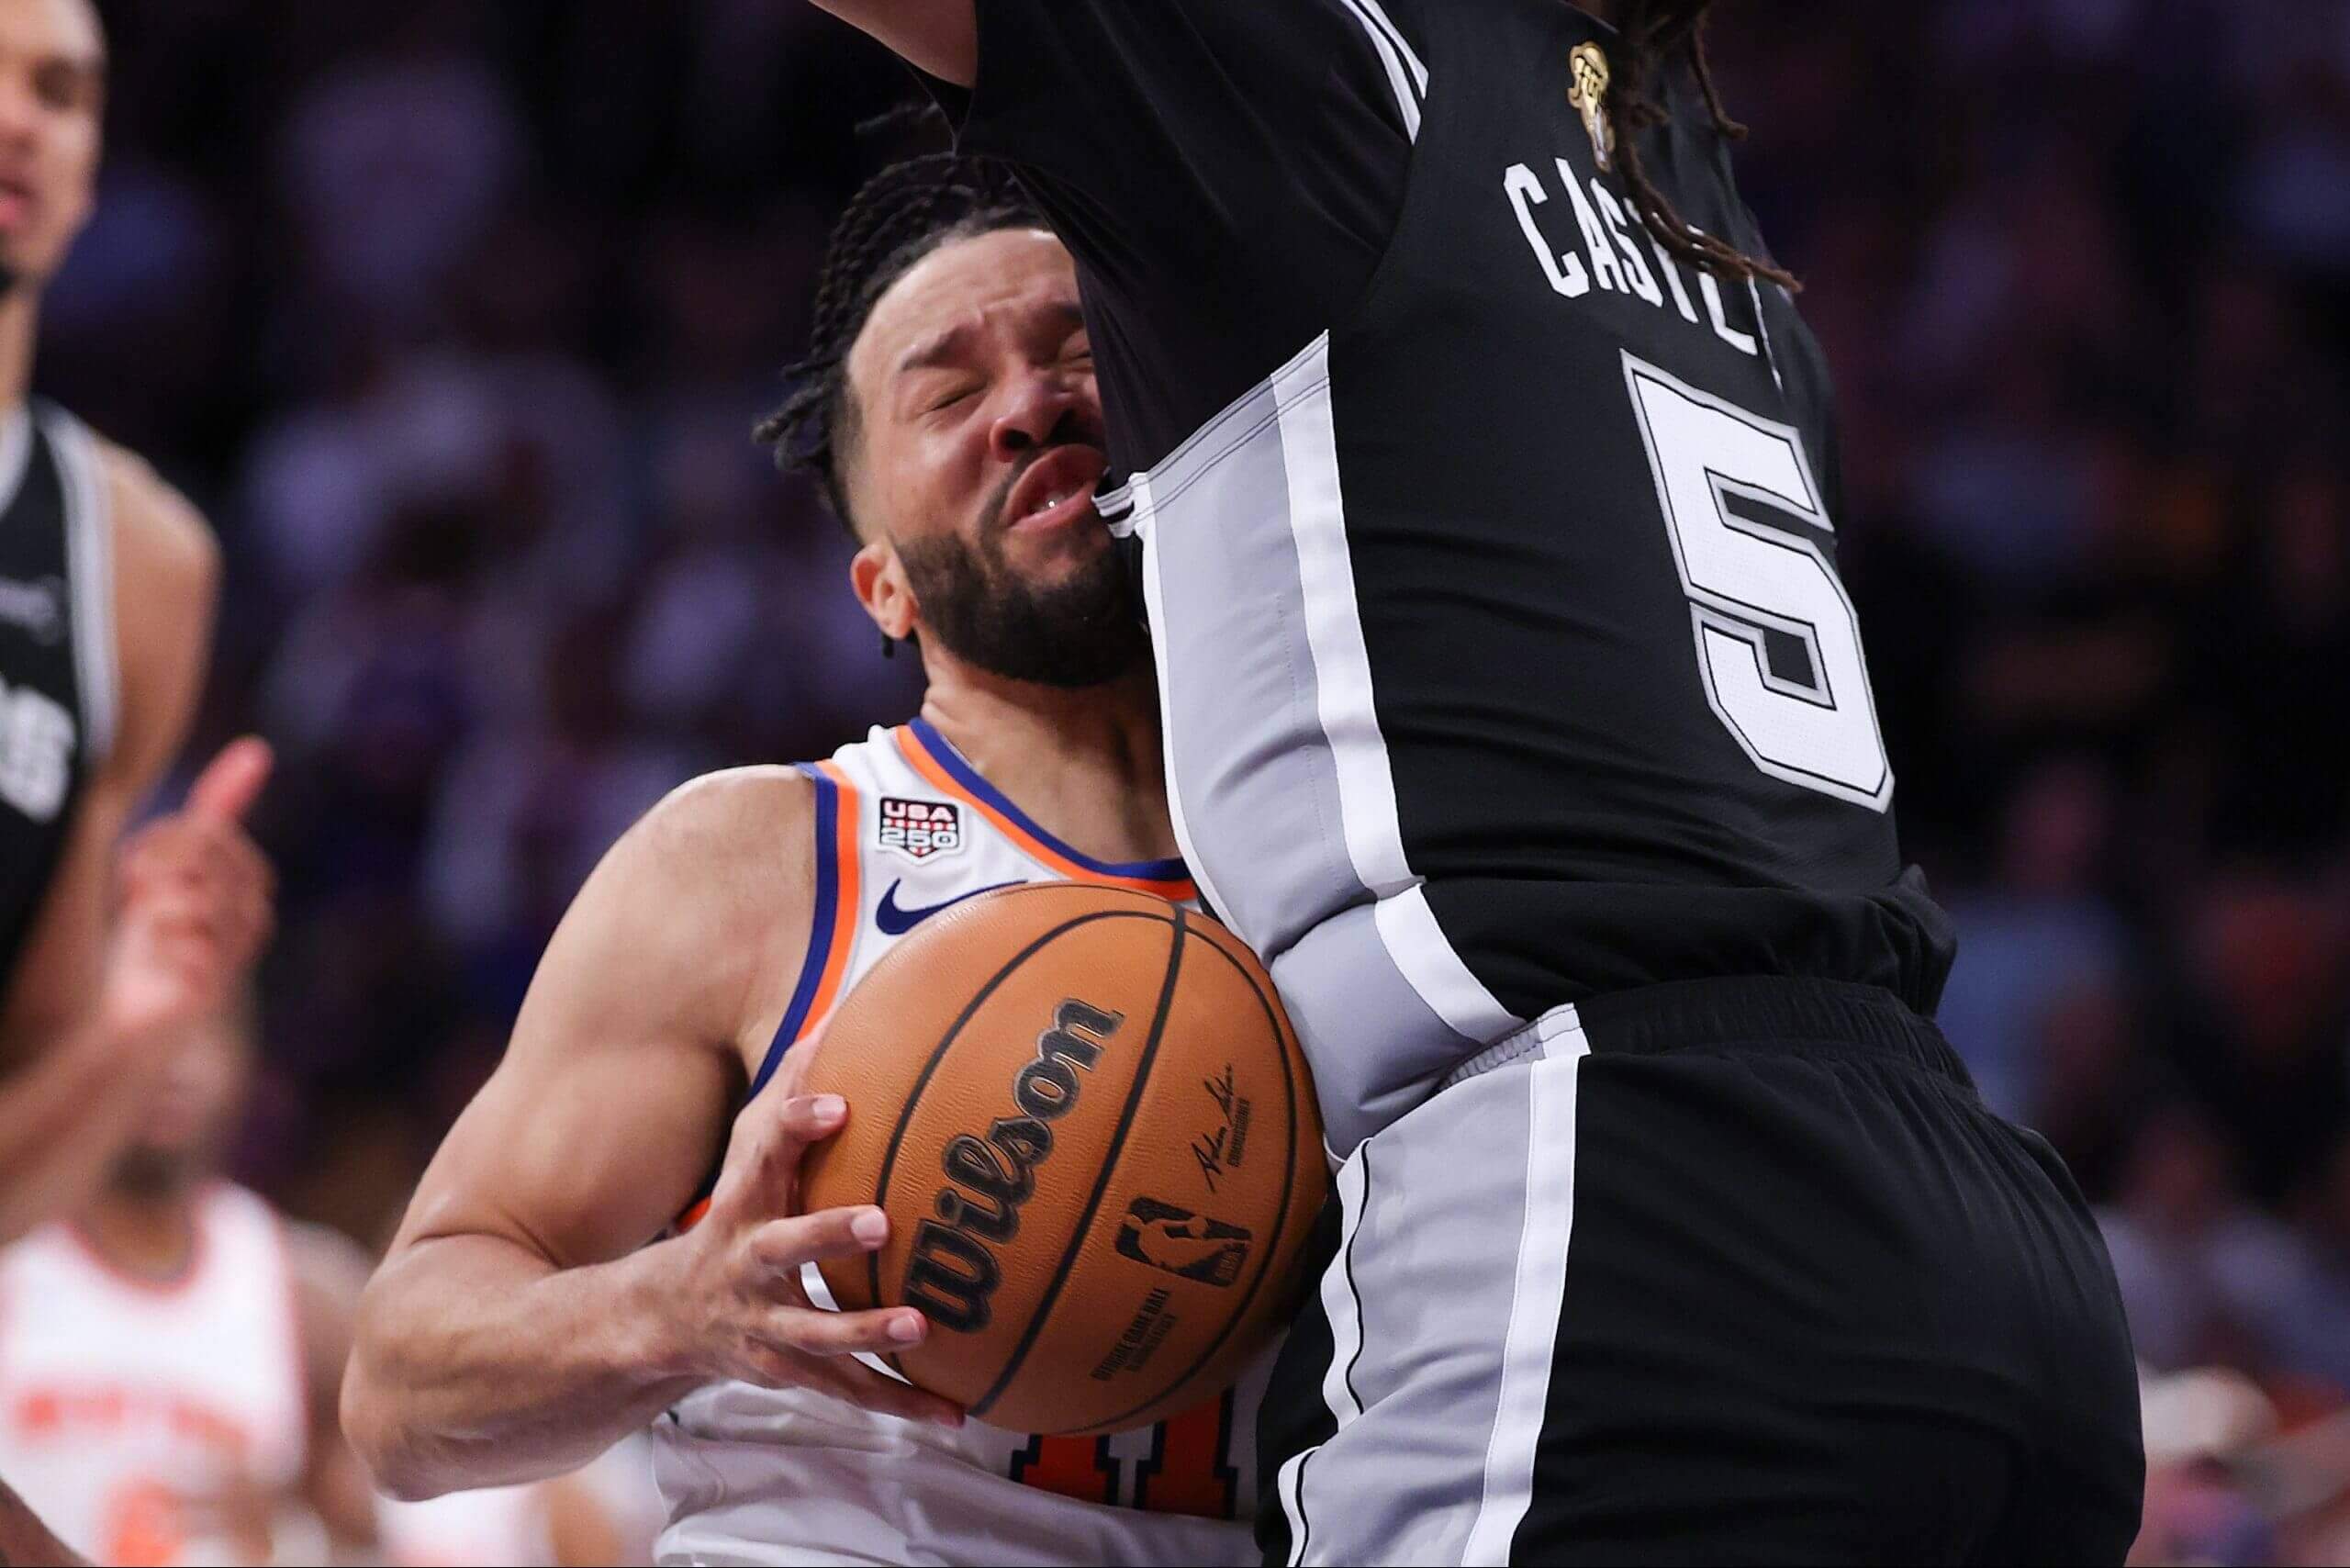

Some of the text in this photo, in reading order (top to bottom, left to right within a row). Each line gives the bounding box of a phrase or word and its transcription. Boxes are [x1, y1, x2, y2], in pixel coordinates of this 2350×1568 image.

[1503, 157, 1783, 391] CASTL
[1619, 347, 1896, 813] 5
[880, 826, 959, 848] 250
[883, 800, 955, 823] USA
[903, 997, 1126, 1334] Wilson
